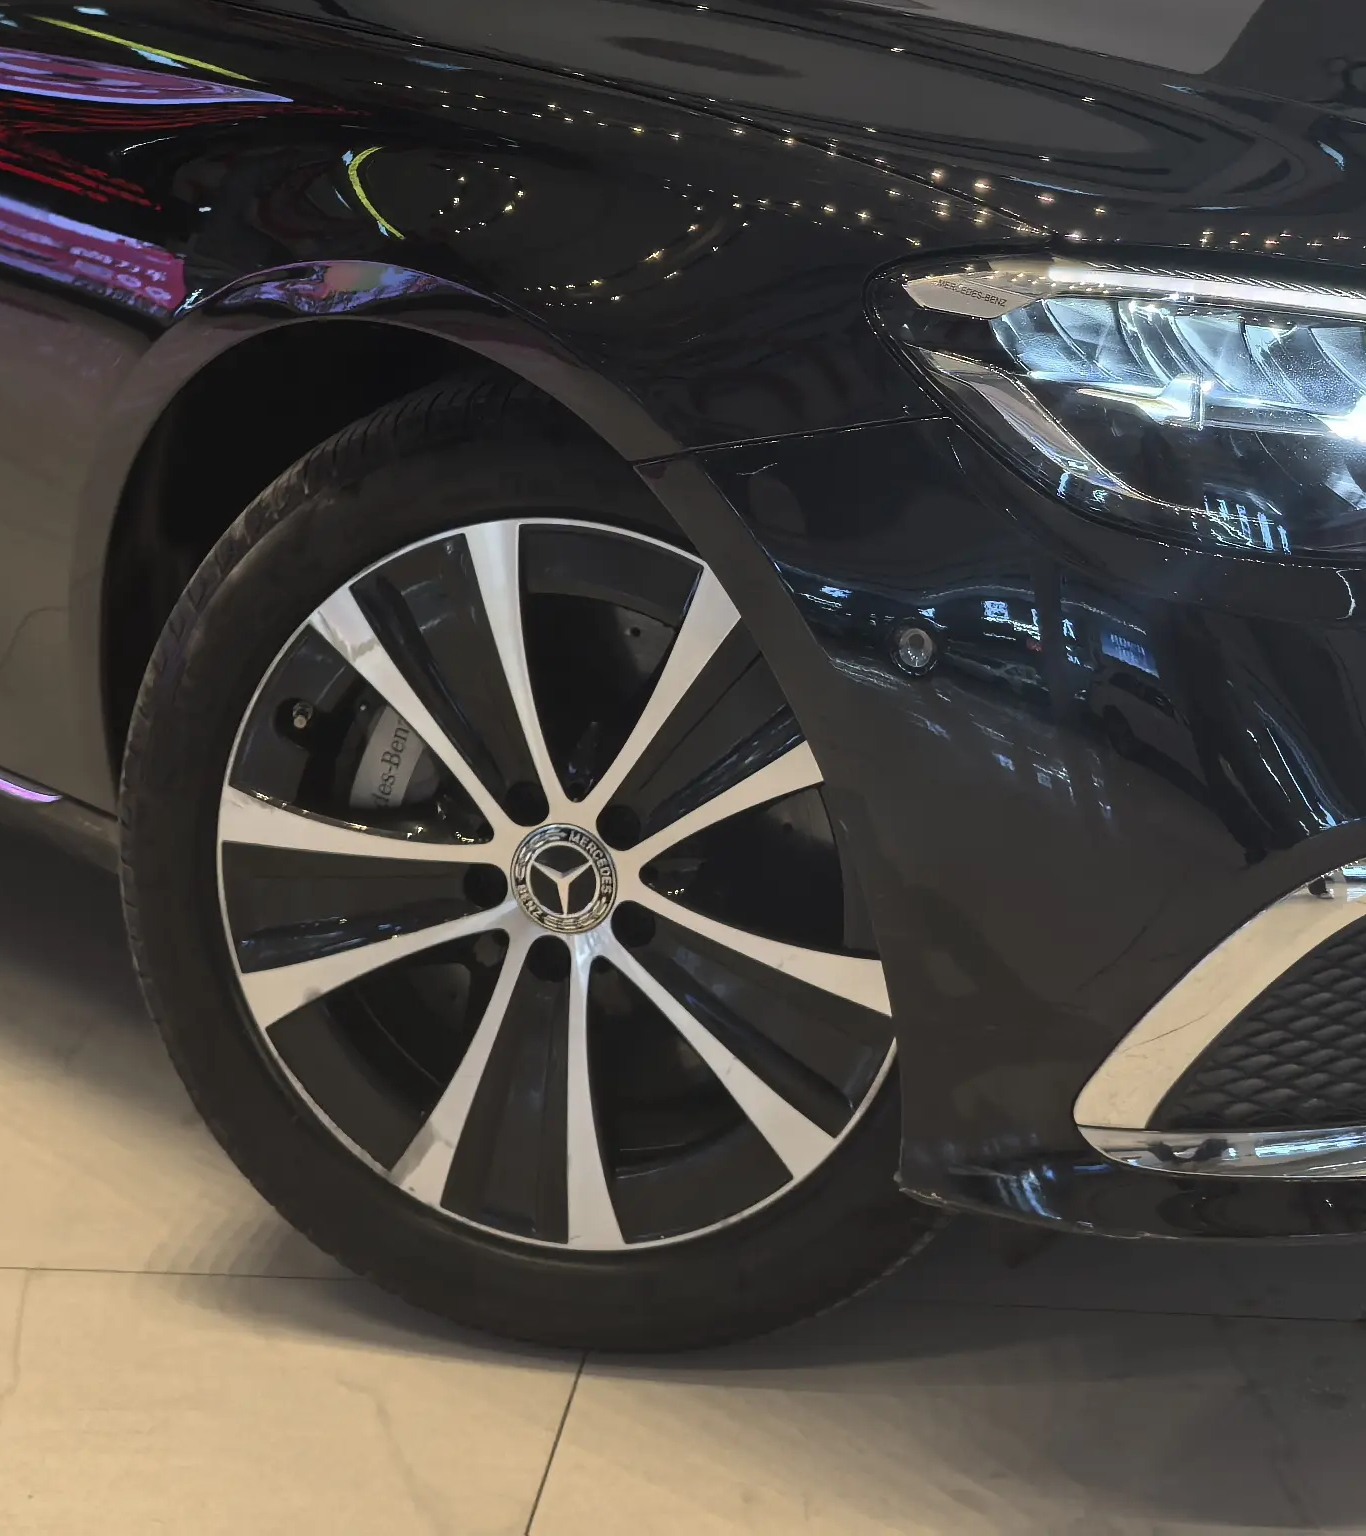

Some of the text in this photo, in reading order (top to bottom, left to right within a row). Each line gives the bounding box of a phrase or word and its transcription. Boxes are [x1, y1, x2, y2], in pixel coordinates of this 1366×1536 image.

[937, 278, 1008, 308] MERCEDES-BENZ
[567, 830, 613, 895] MERCEDES
[516, 883, 544, 920] BENZ
